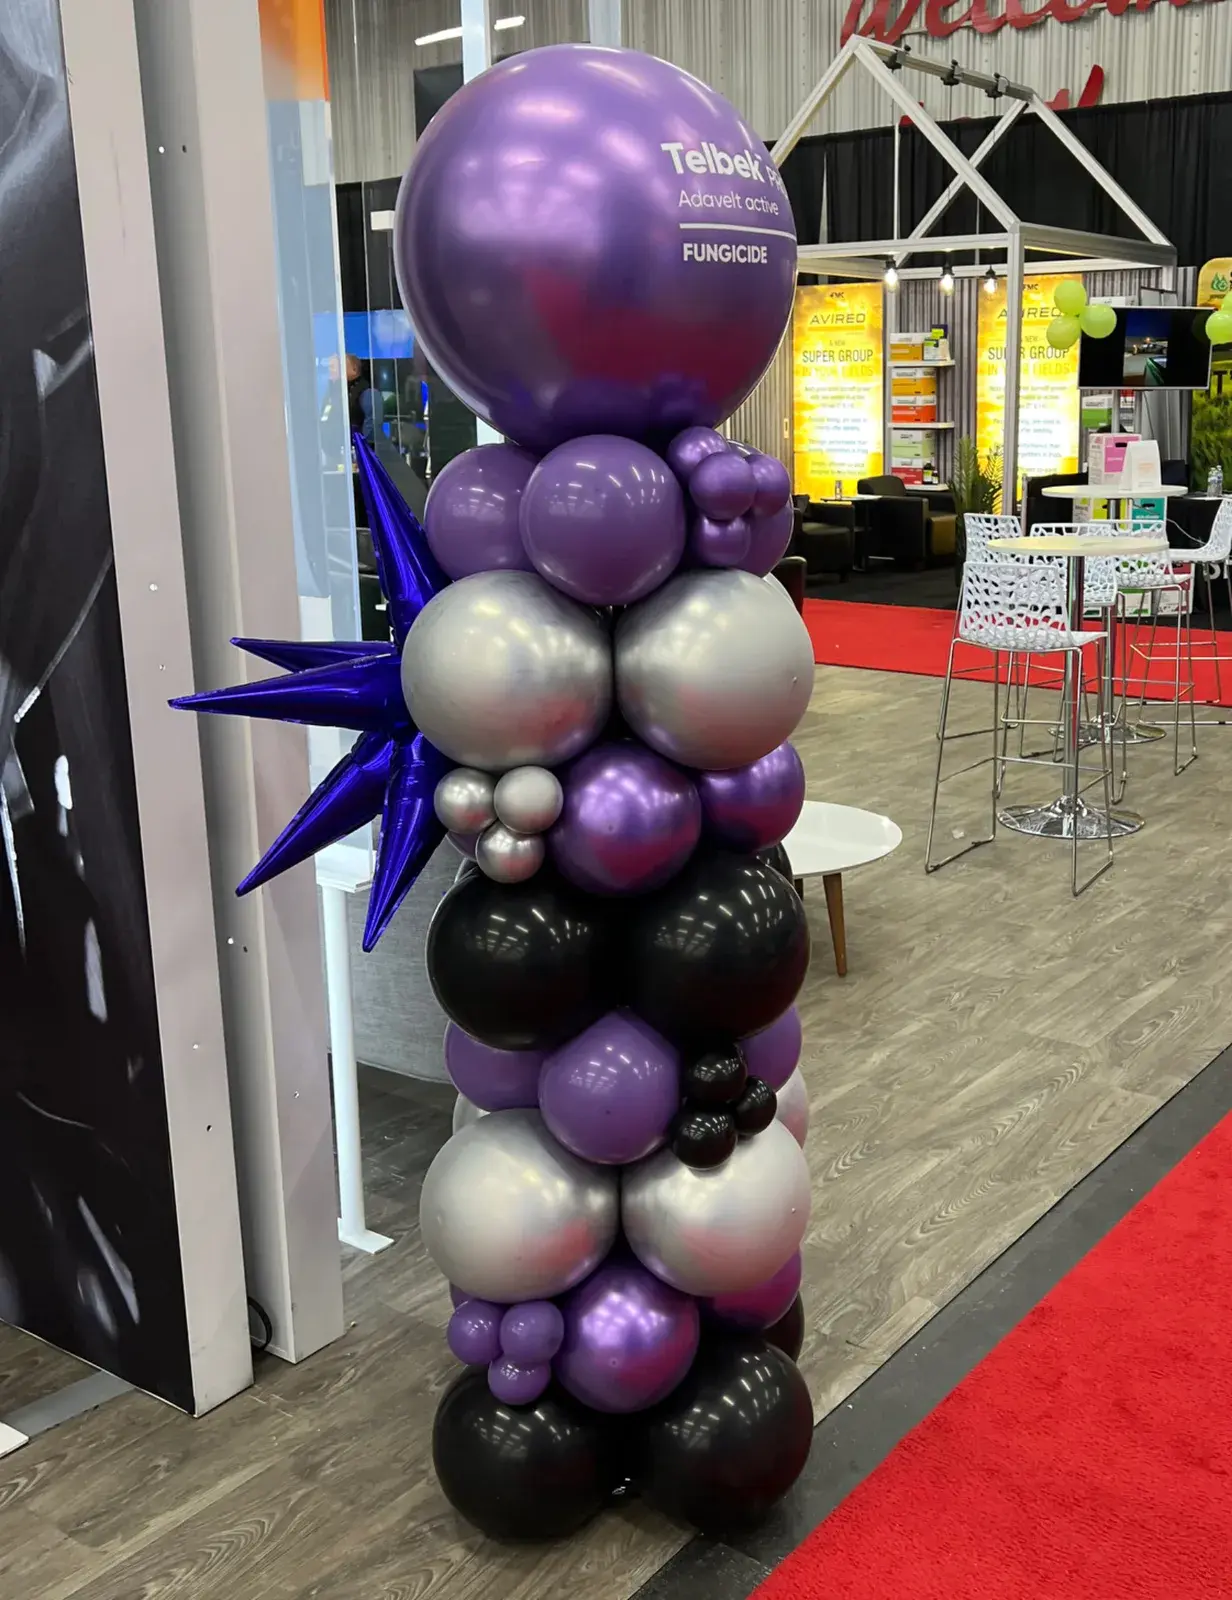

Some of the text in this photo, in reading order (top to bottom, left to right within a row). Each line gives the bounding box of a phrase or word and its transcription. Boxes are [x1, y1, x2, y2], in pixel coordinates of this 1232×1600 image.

[678, 189, 779, 216] Adavelt active
[683, 243, 768, 264] FUNGICIDE
[802, 349, 873, 363] SUPER GROUP
